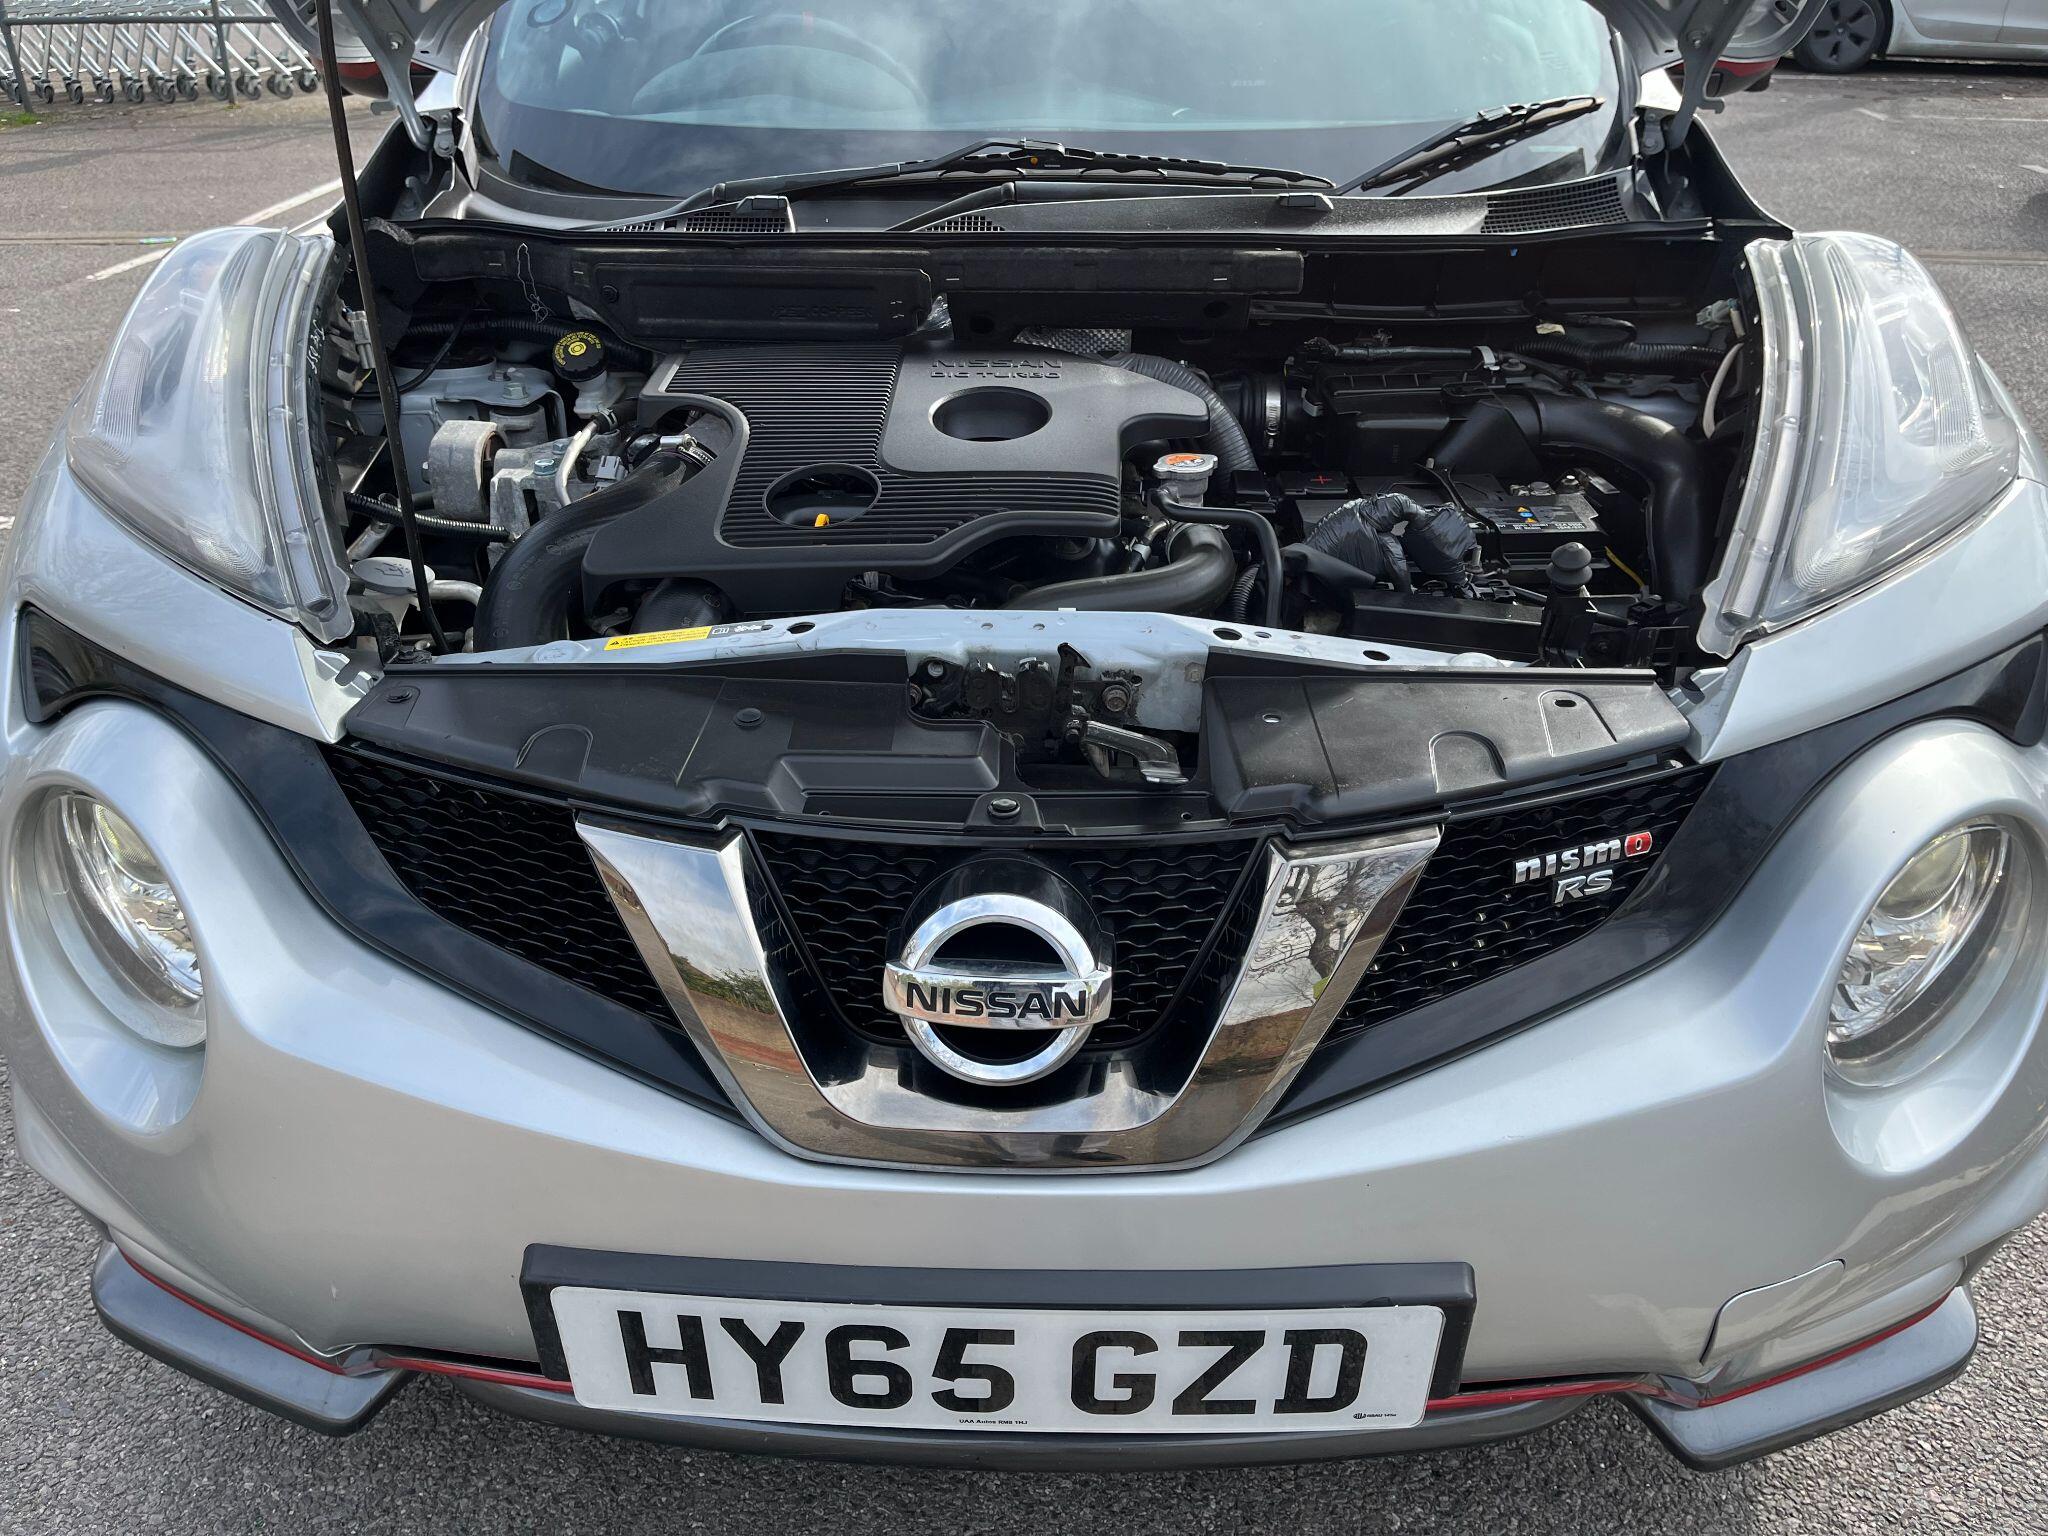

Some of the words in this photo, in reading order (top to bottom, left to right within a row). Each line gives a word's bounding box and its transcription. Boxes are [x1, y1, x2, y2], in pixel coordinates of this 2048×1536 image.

[931, 359, 1063, 369] NISSAN
[976, 371, 1062, 379] TURBO
[1515, 831, 1652, 884] nismo
[1554, 869, 1613, 904] RS
[906, 982, 1087, 1019] NISSAN
[617, 1310, 1015, 1413] HY65
[1071, 1328, 1368, 1415] GZD
